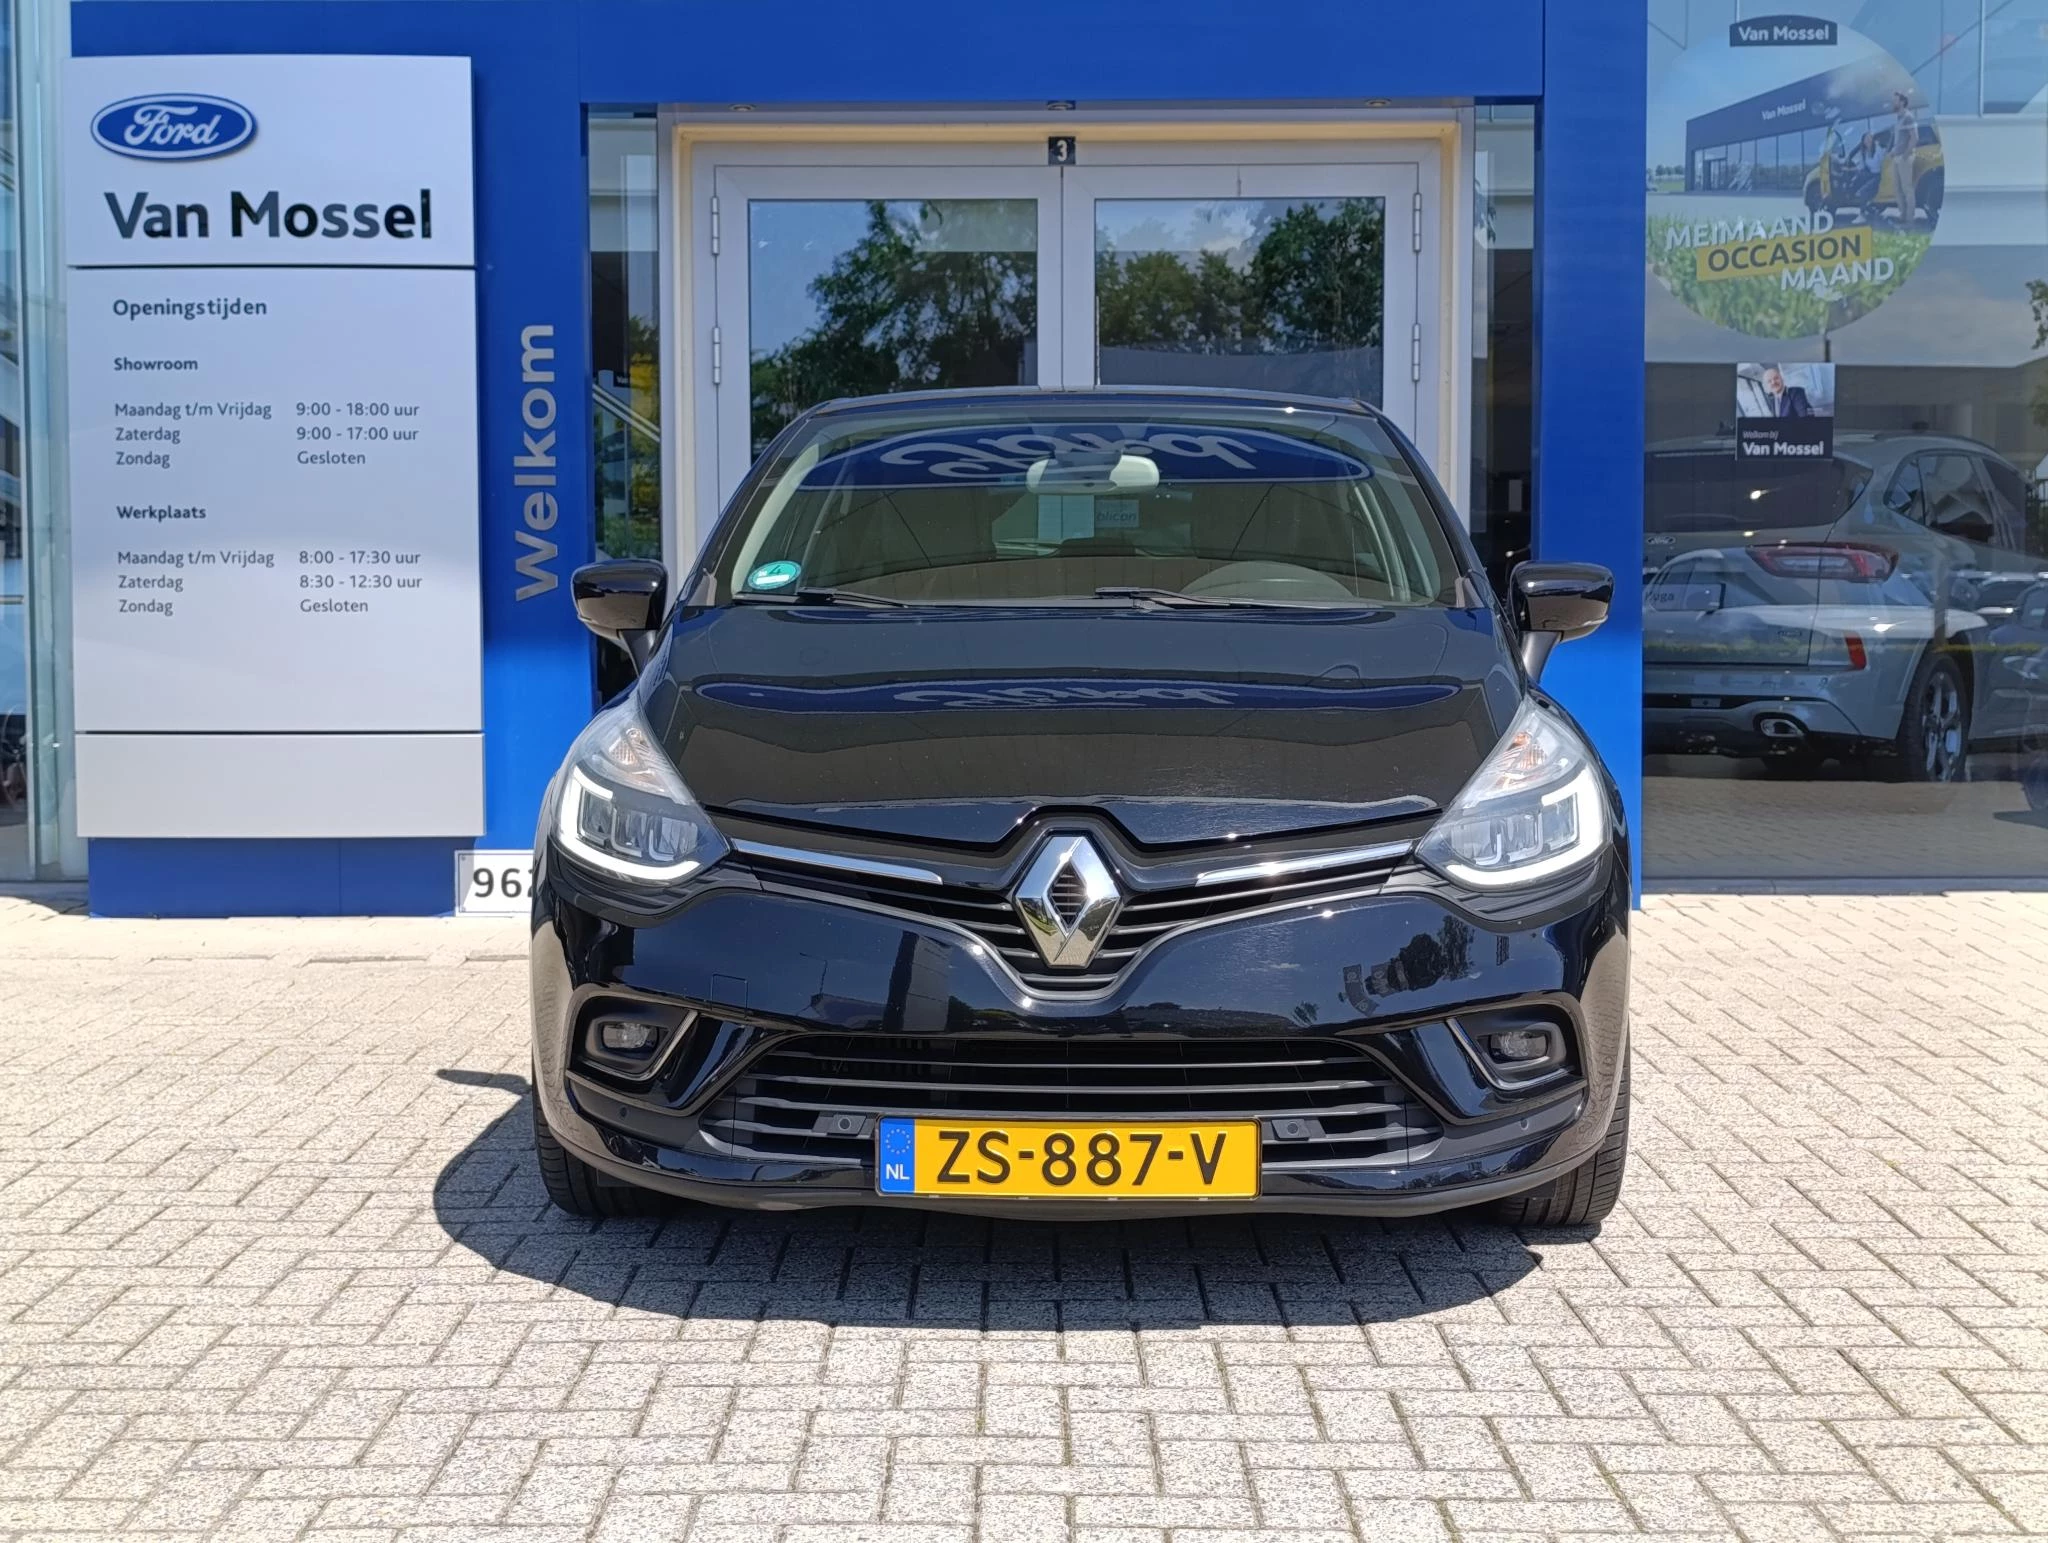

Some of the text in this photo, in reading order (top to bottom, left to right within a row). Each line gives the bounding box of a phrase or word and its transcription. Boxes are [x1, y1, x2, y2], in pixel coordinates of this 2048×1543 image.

[1738, 24, 1830, 41] Van Mossel
[123, 104, 222, 146] Ford
[1057, 139, 1068, 162] 3
[104, 188, 432, 239] Van Mossel
[1665, 210, 1835, 250] MEIMAAND
[1707, 234, 1862, 272] OCCASION
[1780, 256, 1895, 292] MAAND
[112, 297, 267, 323] Openingstijden
[113, 356, 199, 373] Showroom
[115, 402, 182, 421] Maandag
[185, 402, 213, 417] t/m
[216, 401, 272, 421] Vrijdag
[296, 401, 331, 417] 9:00
[346, 401, 390, 417] 18:00
[394, 405, 420, 417] uur
[115, 426, 181, 445] Zaterdag
[296, 426, 332, 441] 9:00
[346, 426, 389, 441] 17:00
[392, 430, 419, 441] uur
[1742, 440, 1824, 456] Van Mossel
[115, 450, 366, 470] Zondag Gesloten
[513, 324, 559, 602] Welkom
[116, 504, 207, 523] Werkplaats
[117, 550, 185, 569] Maandag
[188, 550, 216, 565] t/m
[220, 550, 275, 569] Vrijdag
[299, 550, 334, 565] 8:00
[349, 550, 391, 565] 17:30
[395, 553, 421, 565] uur
[118, 574, 184, 593] Zaterdag
[299, 574, 335, 589] 8:30
[350, 574, 393, 589] 12:30
[397, 578, 423, 589] uur
[119, 598, 369, 617] Zondag Gesloten
[937, 1130, 1226, 1186] ZS-887-V
[885, 1163, 910, 1180] NL
